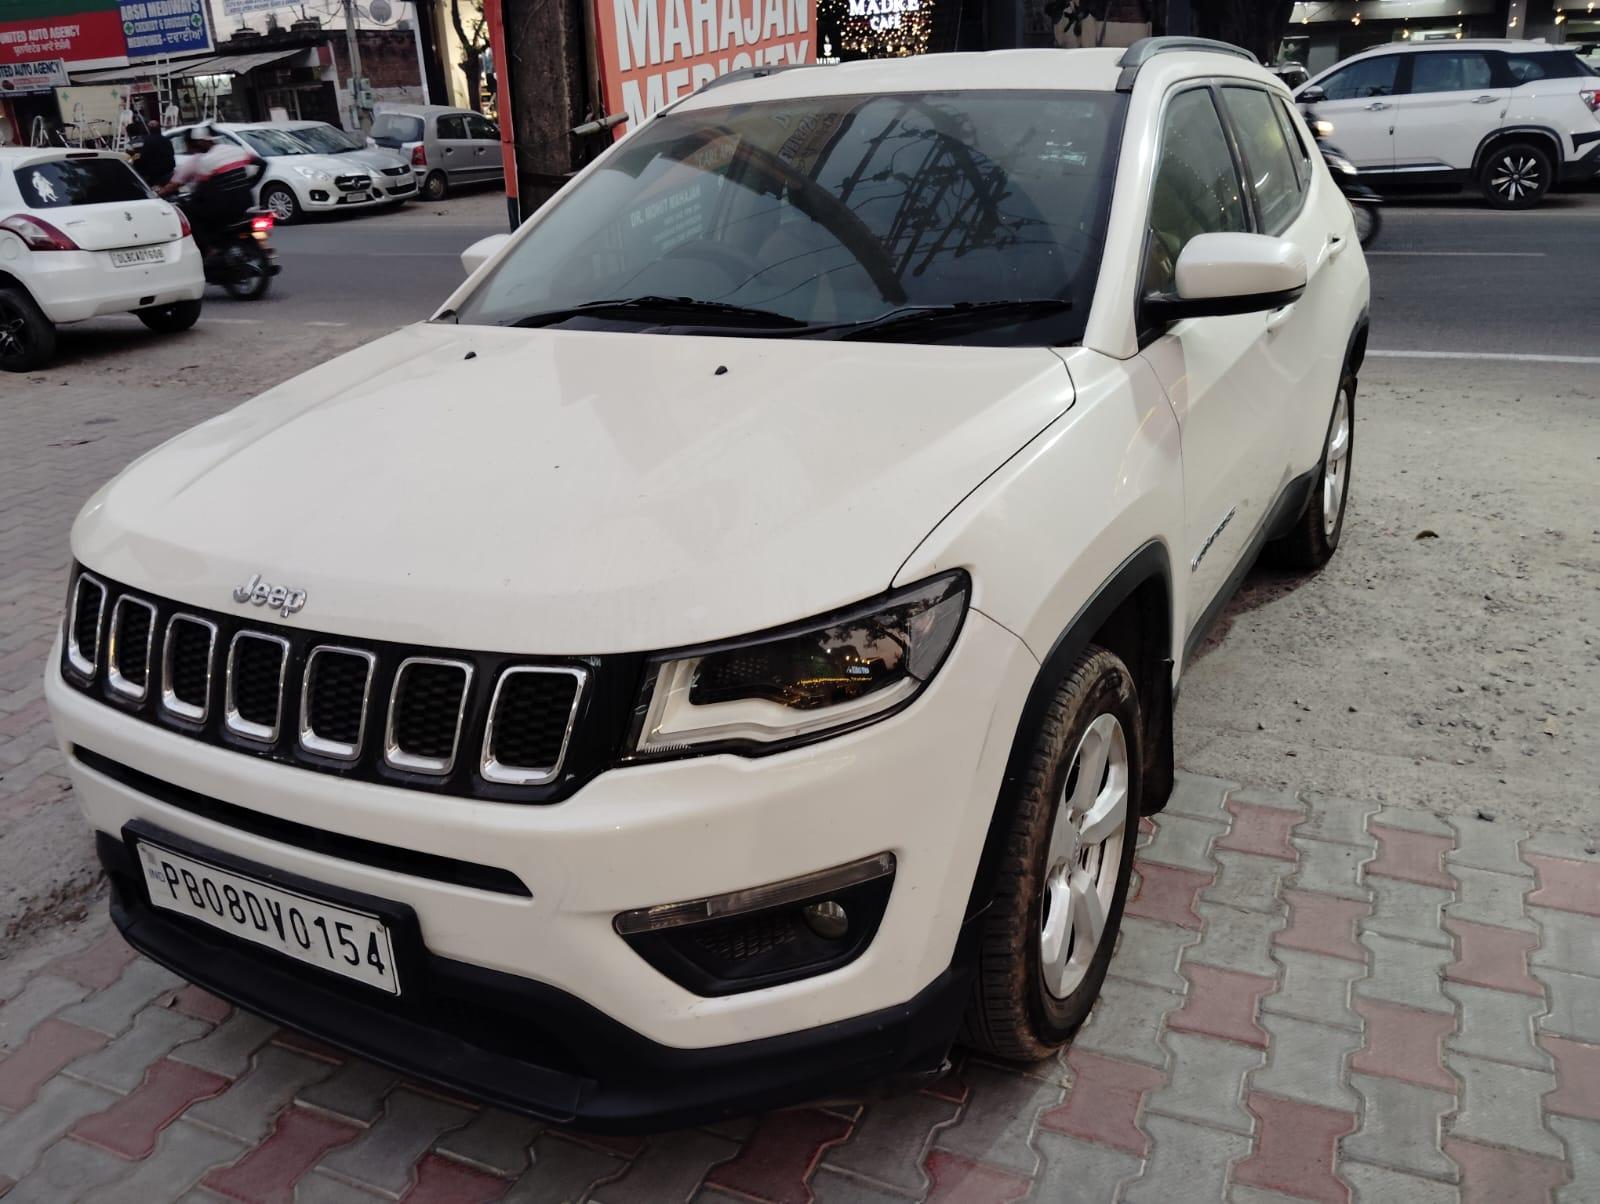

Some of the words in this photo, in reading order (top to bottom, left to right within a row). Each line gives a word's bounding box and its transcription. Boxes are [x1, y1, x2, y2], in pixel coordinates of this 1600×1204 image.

[28, 28, 49, 41] AUTO
[49, 24, 80, 38] AGENCY
[613, 0, 809, 72] MAHAJAN
[14, 63, 33, 75] AUTO
[33, 61, 61, 74] AGENCY
[232, 573, 308, 618] Jeep
[160, 860, 386, 976] PB08DV0154
